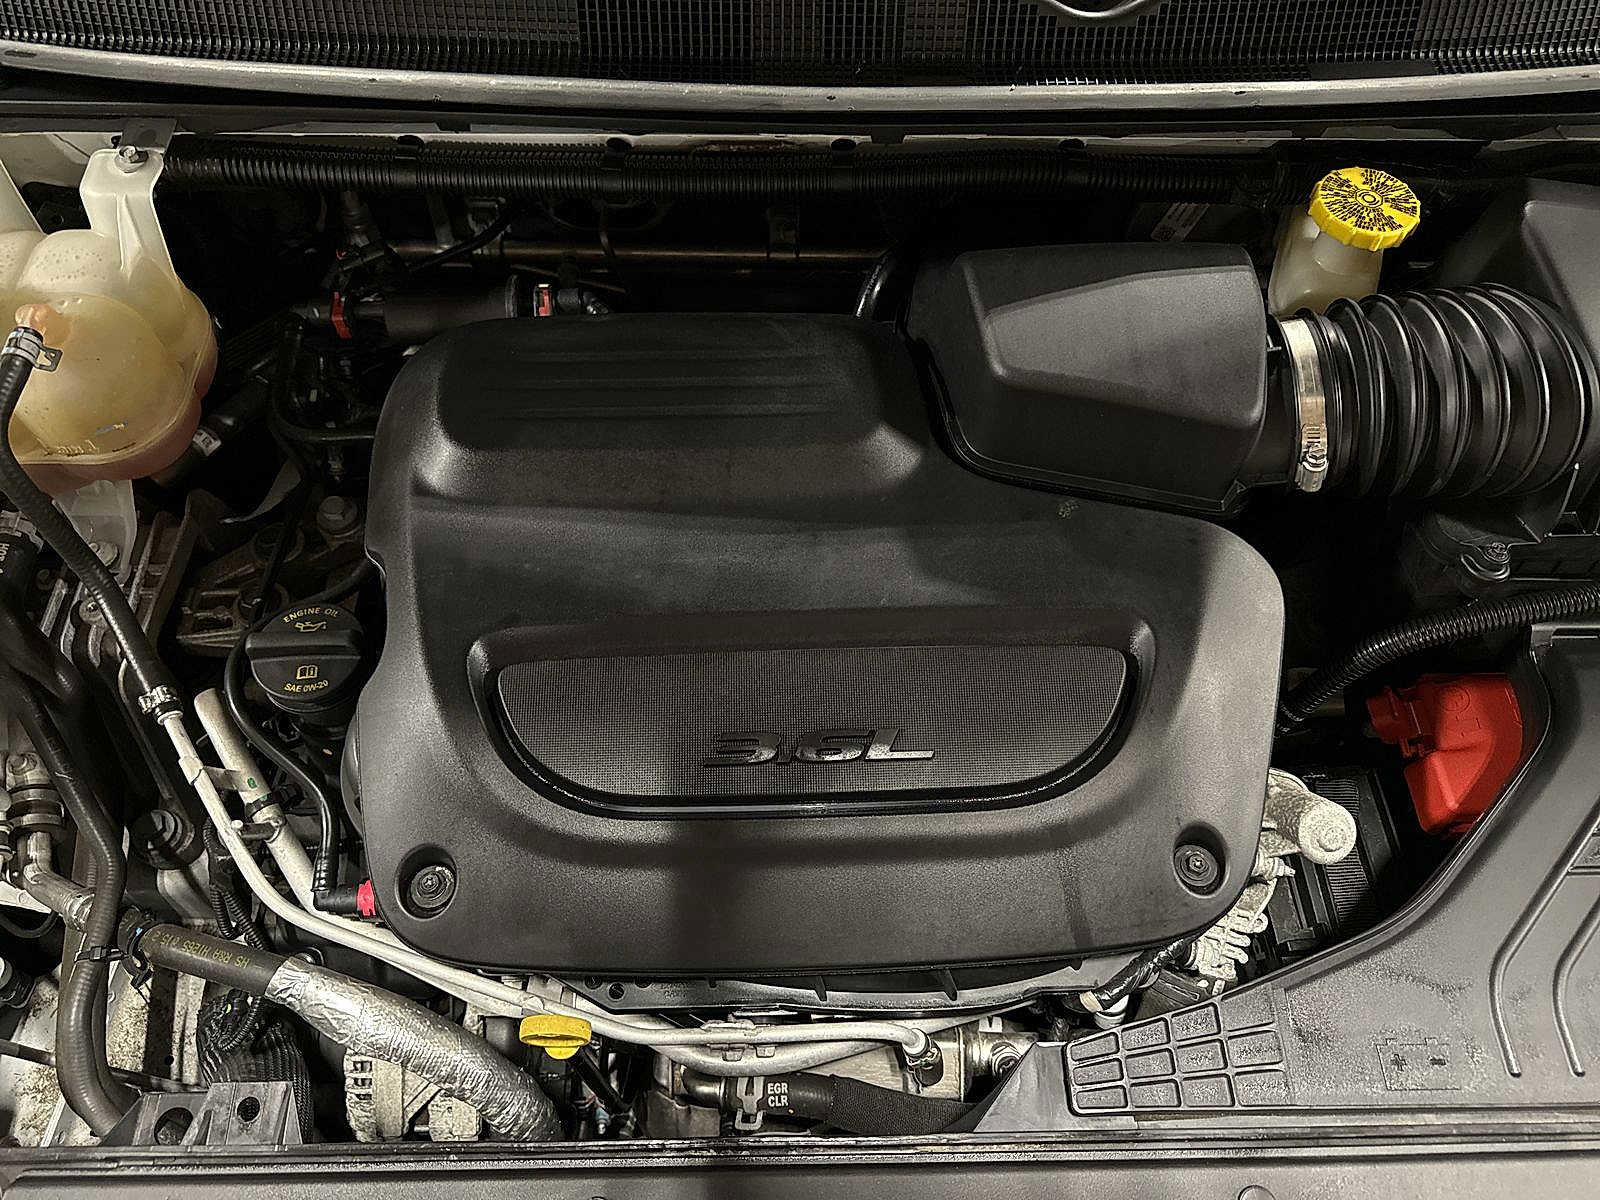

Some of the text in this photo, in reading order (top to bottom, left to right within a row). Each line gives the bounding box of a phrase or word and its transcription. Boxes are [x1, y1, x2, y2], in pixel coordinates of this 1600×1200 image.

[283, 607, 338, 623] ENGINE OIL
[284, 679, 329, 692] SAE 0W-20
[704, 727, 935, 767] 3.6L
[767, 1082, 788, 1094] EGR
[768, 1095, 789, 1107] CLR
